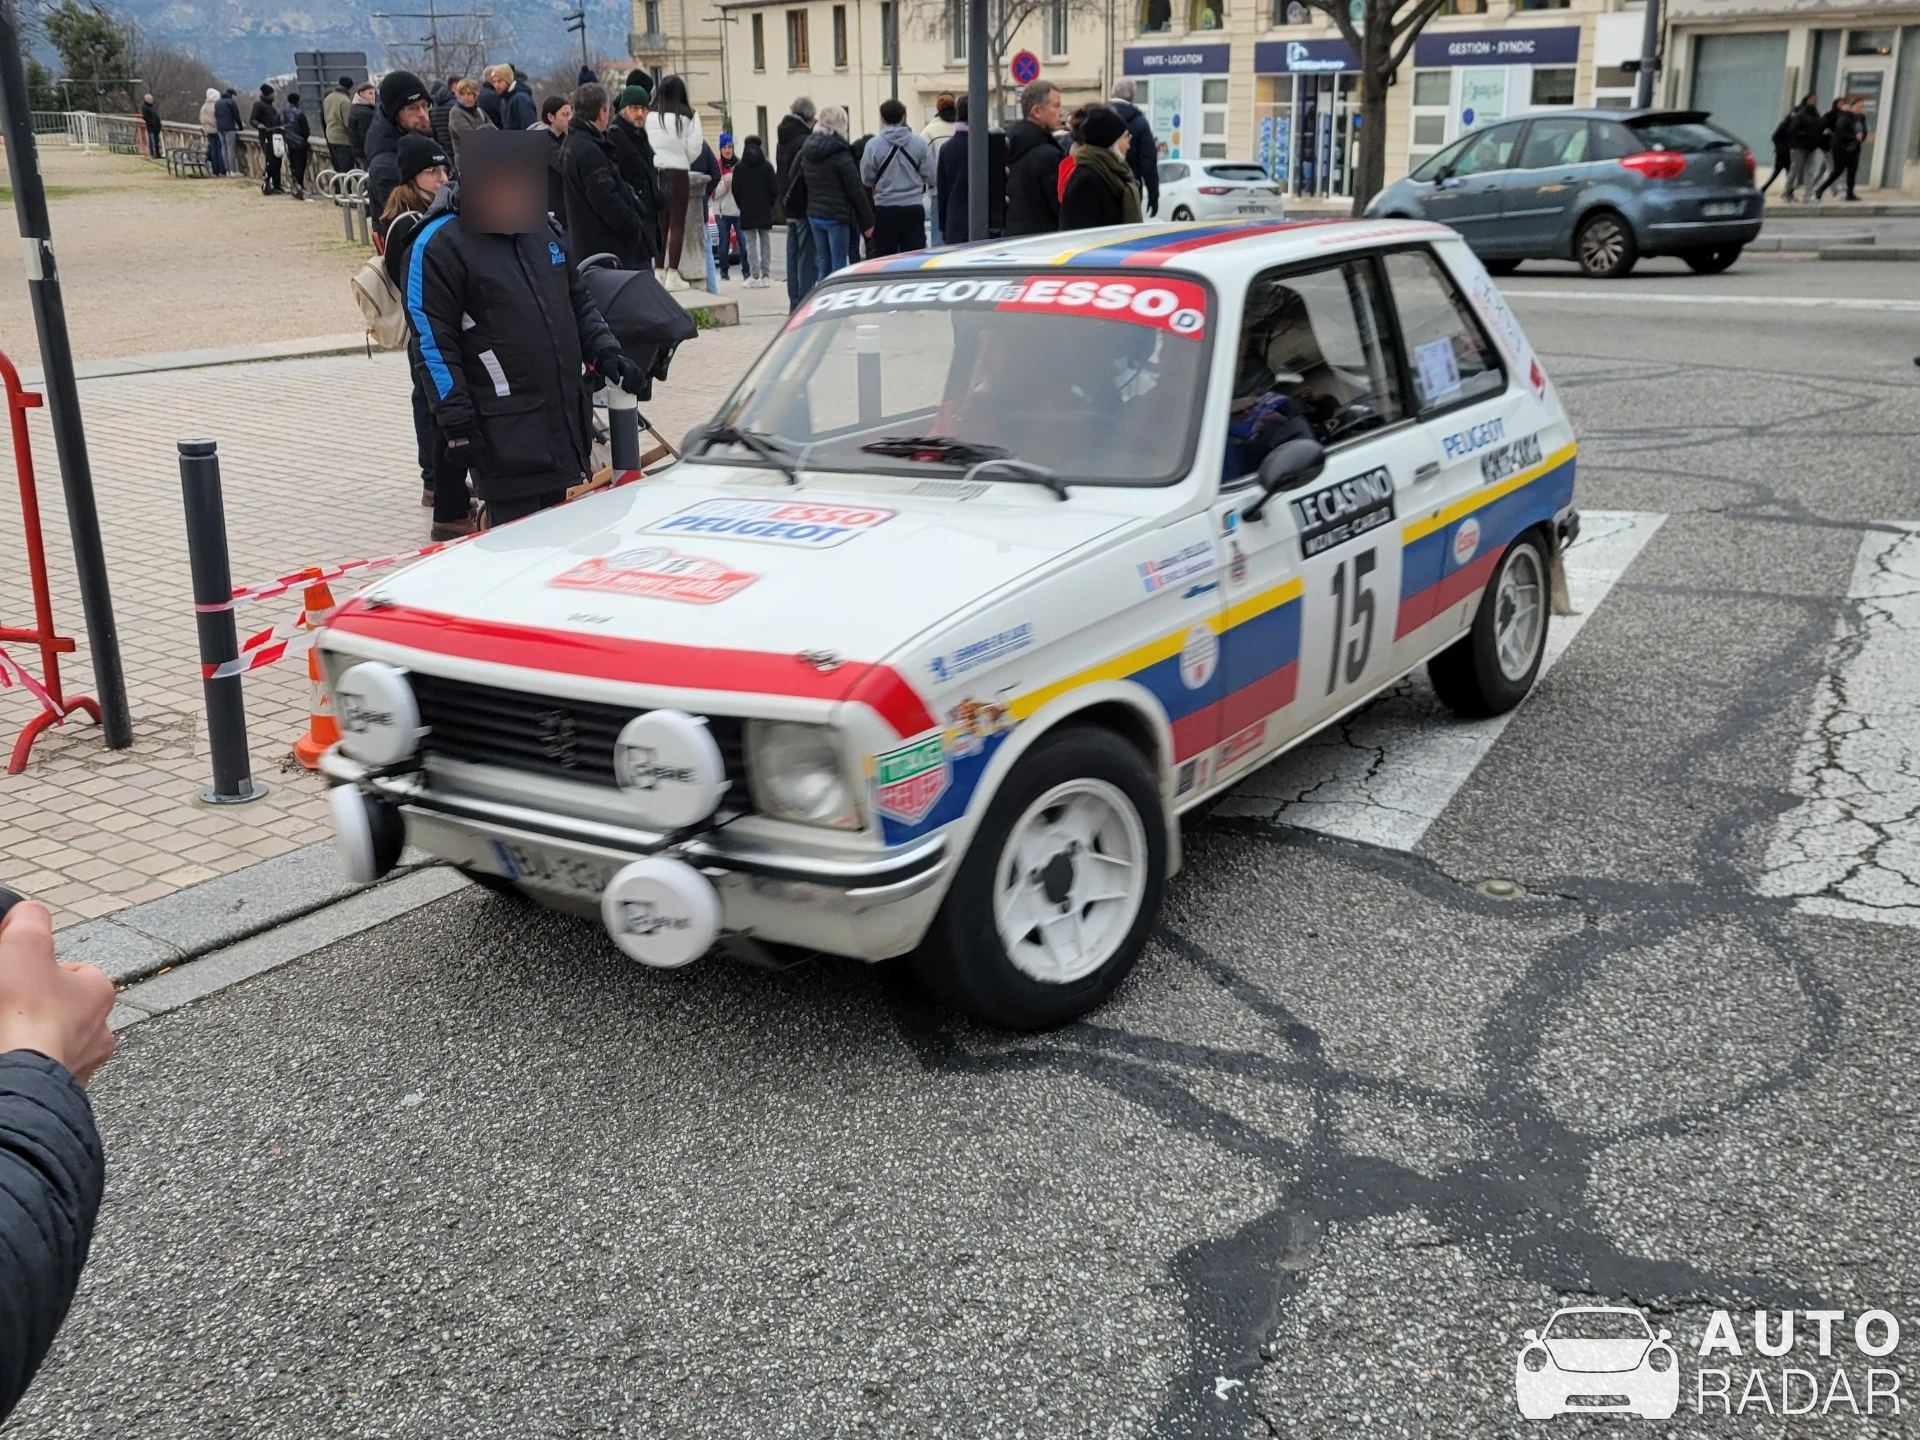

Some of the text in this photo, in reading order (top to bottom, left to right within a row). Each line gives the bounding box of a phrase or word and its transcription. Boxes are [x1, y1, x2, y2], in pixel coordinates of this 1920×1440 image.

[1448, 40, 1536, 56] GESTION SYNDIC
[808, 280, 1013, 318] PEUGEOT
[1021, 280, 1180, 317] ESSO
[1442, 417, 1505, 459] PEUGEOT
[1316, 469, 1393, 521] CASINO
[657, 515, 852, 543] PEUGEOT
[766, 504, 878, 526] ESSO
[658, 557, 697, 574] 15
[1325, 546, 1378, 697] 15
